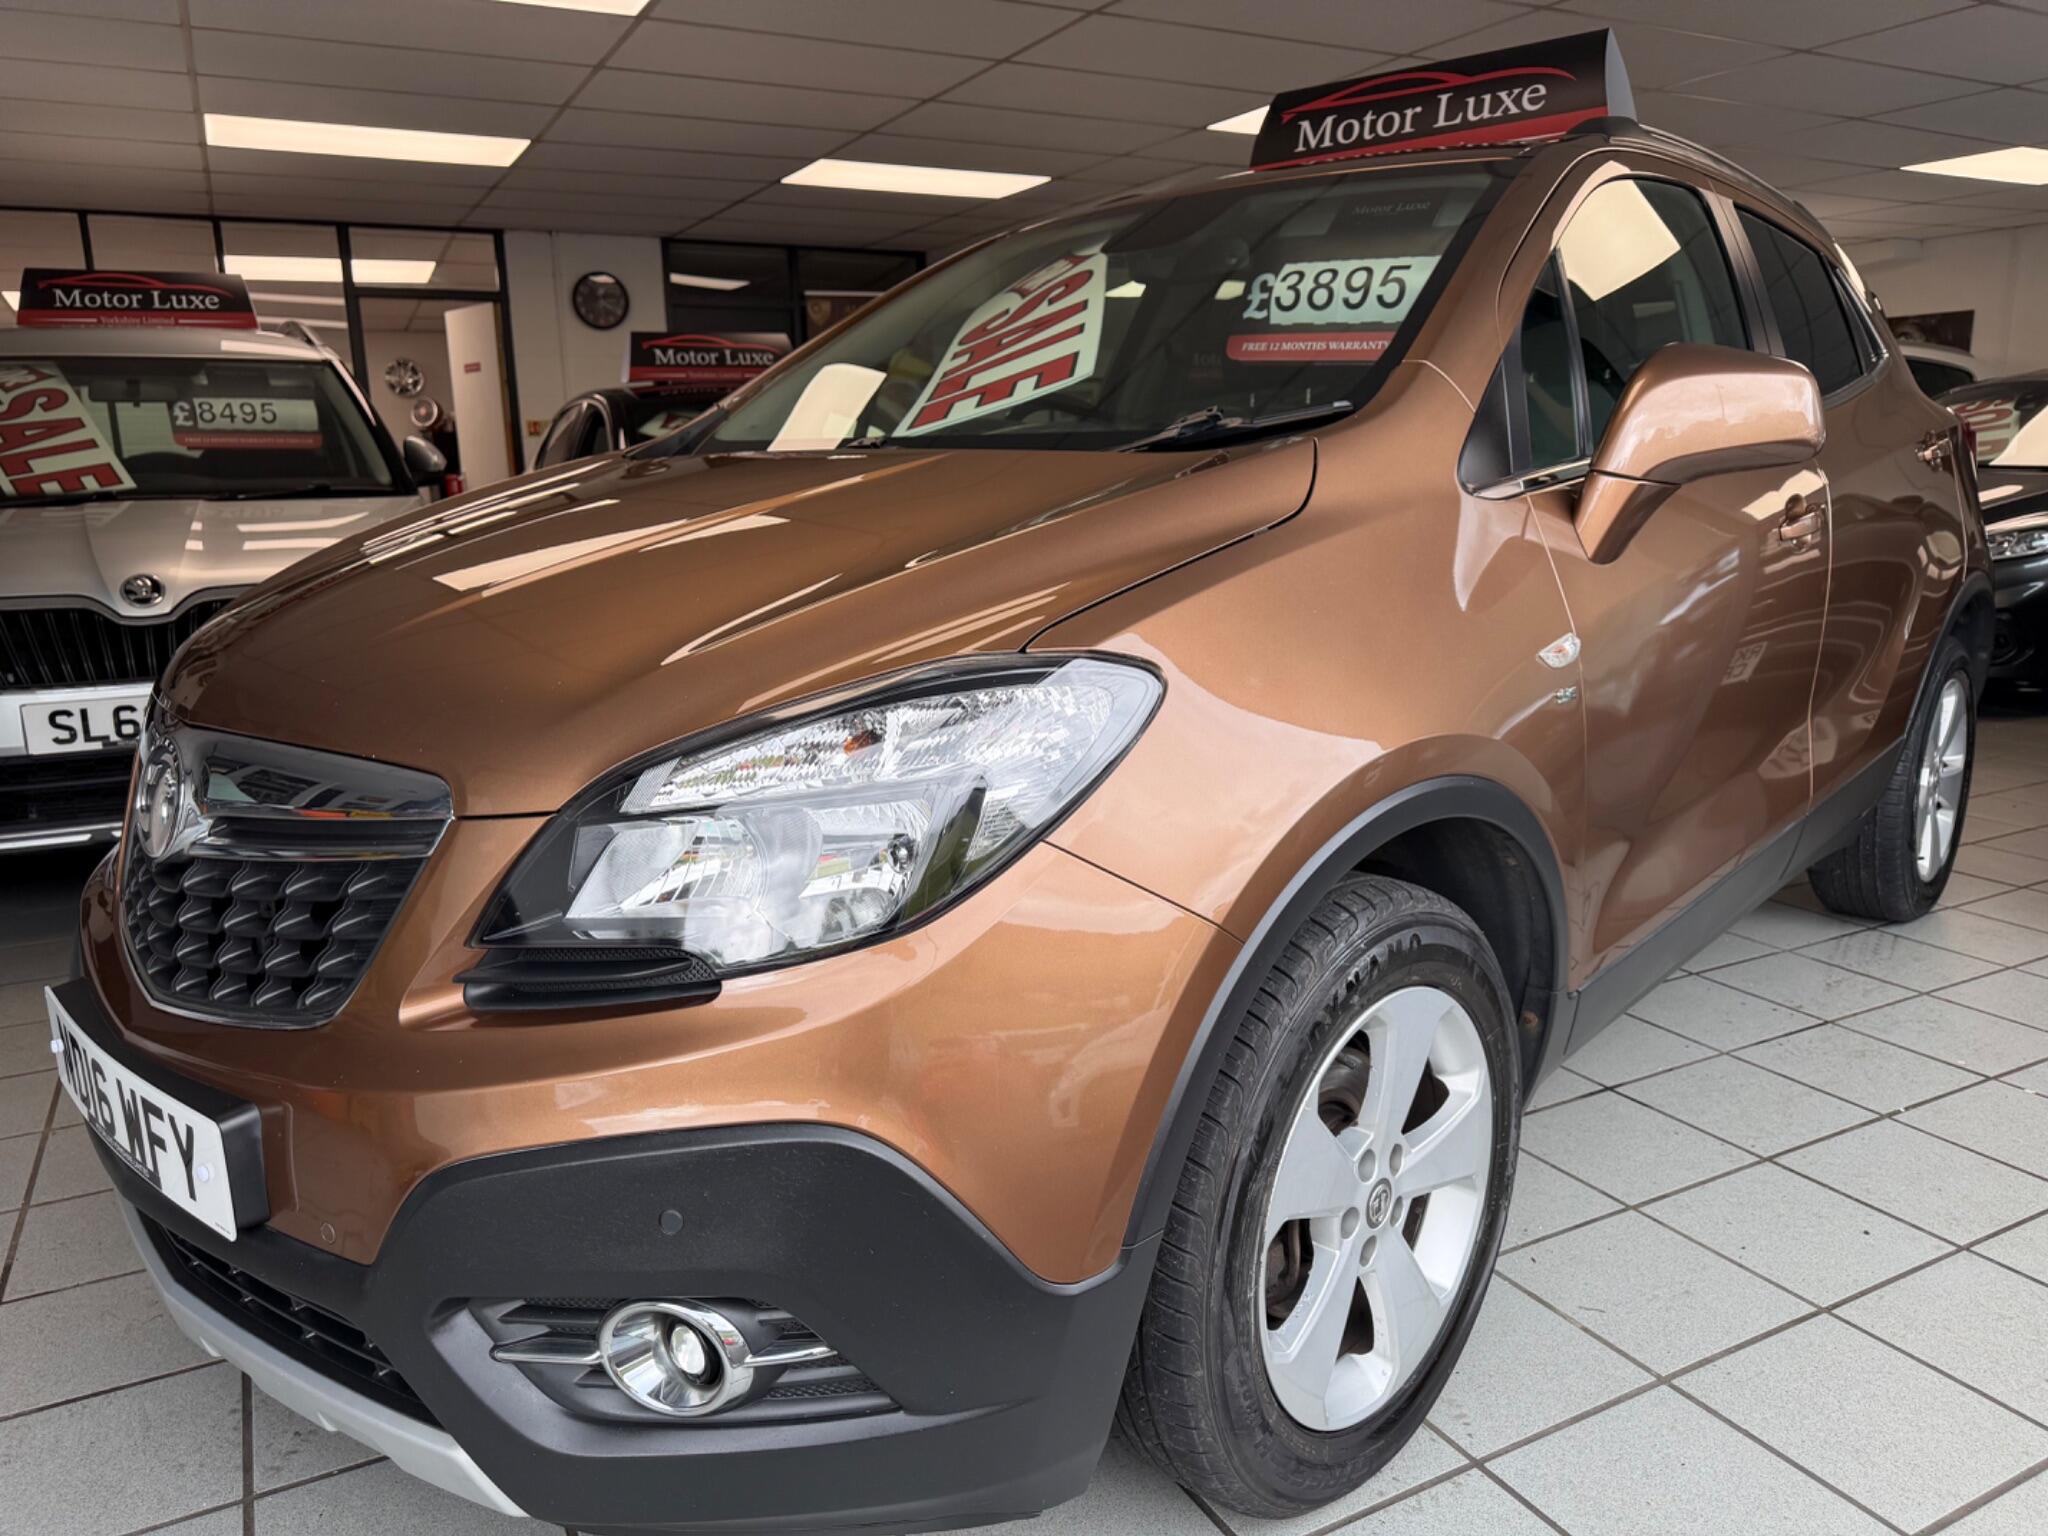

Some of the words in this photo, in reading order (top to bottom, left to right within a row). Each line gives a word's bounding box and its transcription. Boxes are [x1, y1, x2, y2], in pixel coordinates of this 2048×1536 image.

[1294, 105, 1422, 152] Motor
[1433, 82, 1547, 128] Luxe
[53, 288, 143, 309] Motor
[151, 289, 220, 310] Luxe
[1242, 265, 1412, 319] £3895
[653, 348, 719, 365] Motor
[724, 349, 774, 365] Luxe
[908, 268, 1095, 430] SALE
[1241, 341, 1268, 351] FREE
[1269, 341, 1281, 351] 12
[1281, 341, 1327, 351] MONTHS
[172, 401, 277, 427] £8495
[0, 387, 125, 496] SALE
[115, 1077, 198, 1202] WFY
